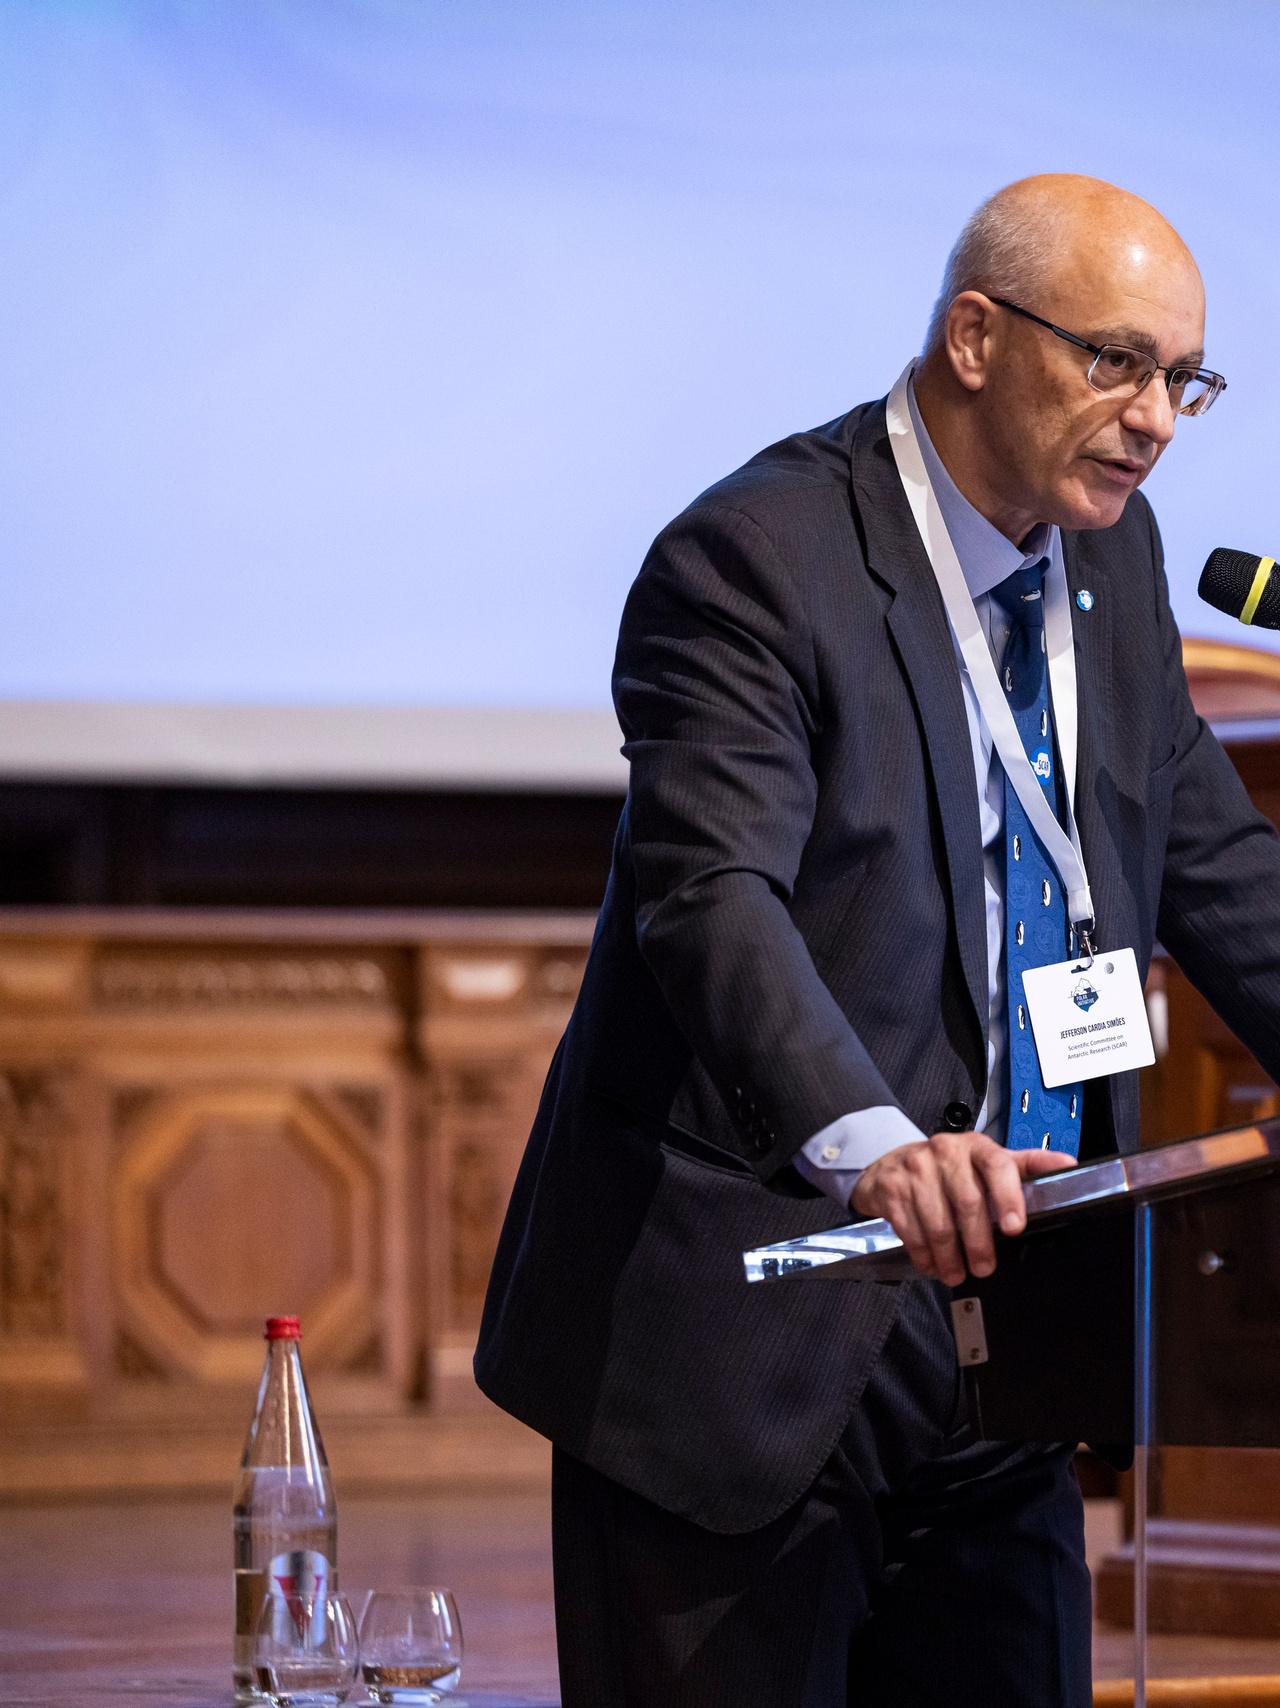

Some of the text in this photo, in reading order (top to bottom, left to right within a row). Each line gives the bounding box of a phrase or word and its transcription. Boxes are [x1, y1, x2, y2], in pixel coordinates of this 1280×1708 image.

[1060, 1017, 1125, 1039] JEFFERSON CARDIA SIMÕES
[1068, 1042, 1089, 1051] Scientific
[1090, 1036, 1116, 1046] Committee
[1068, 1041, 1128, 1059] Antarctic Research (SCAR)
